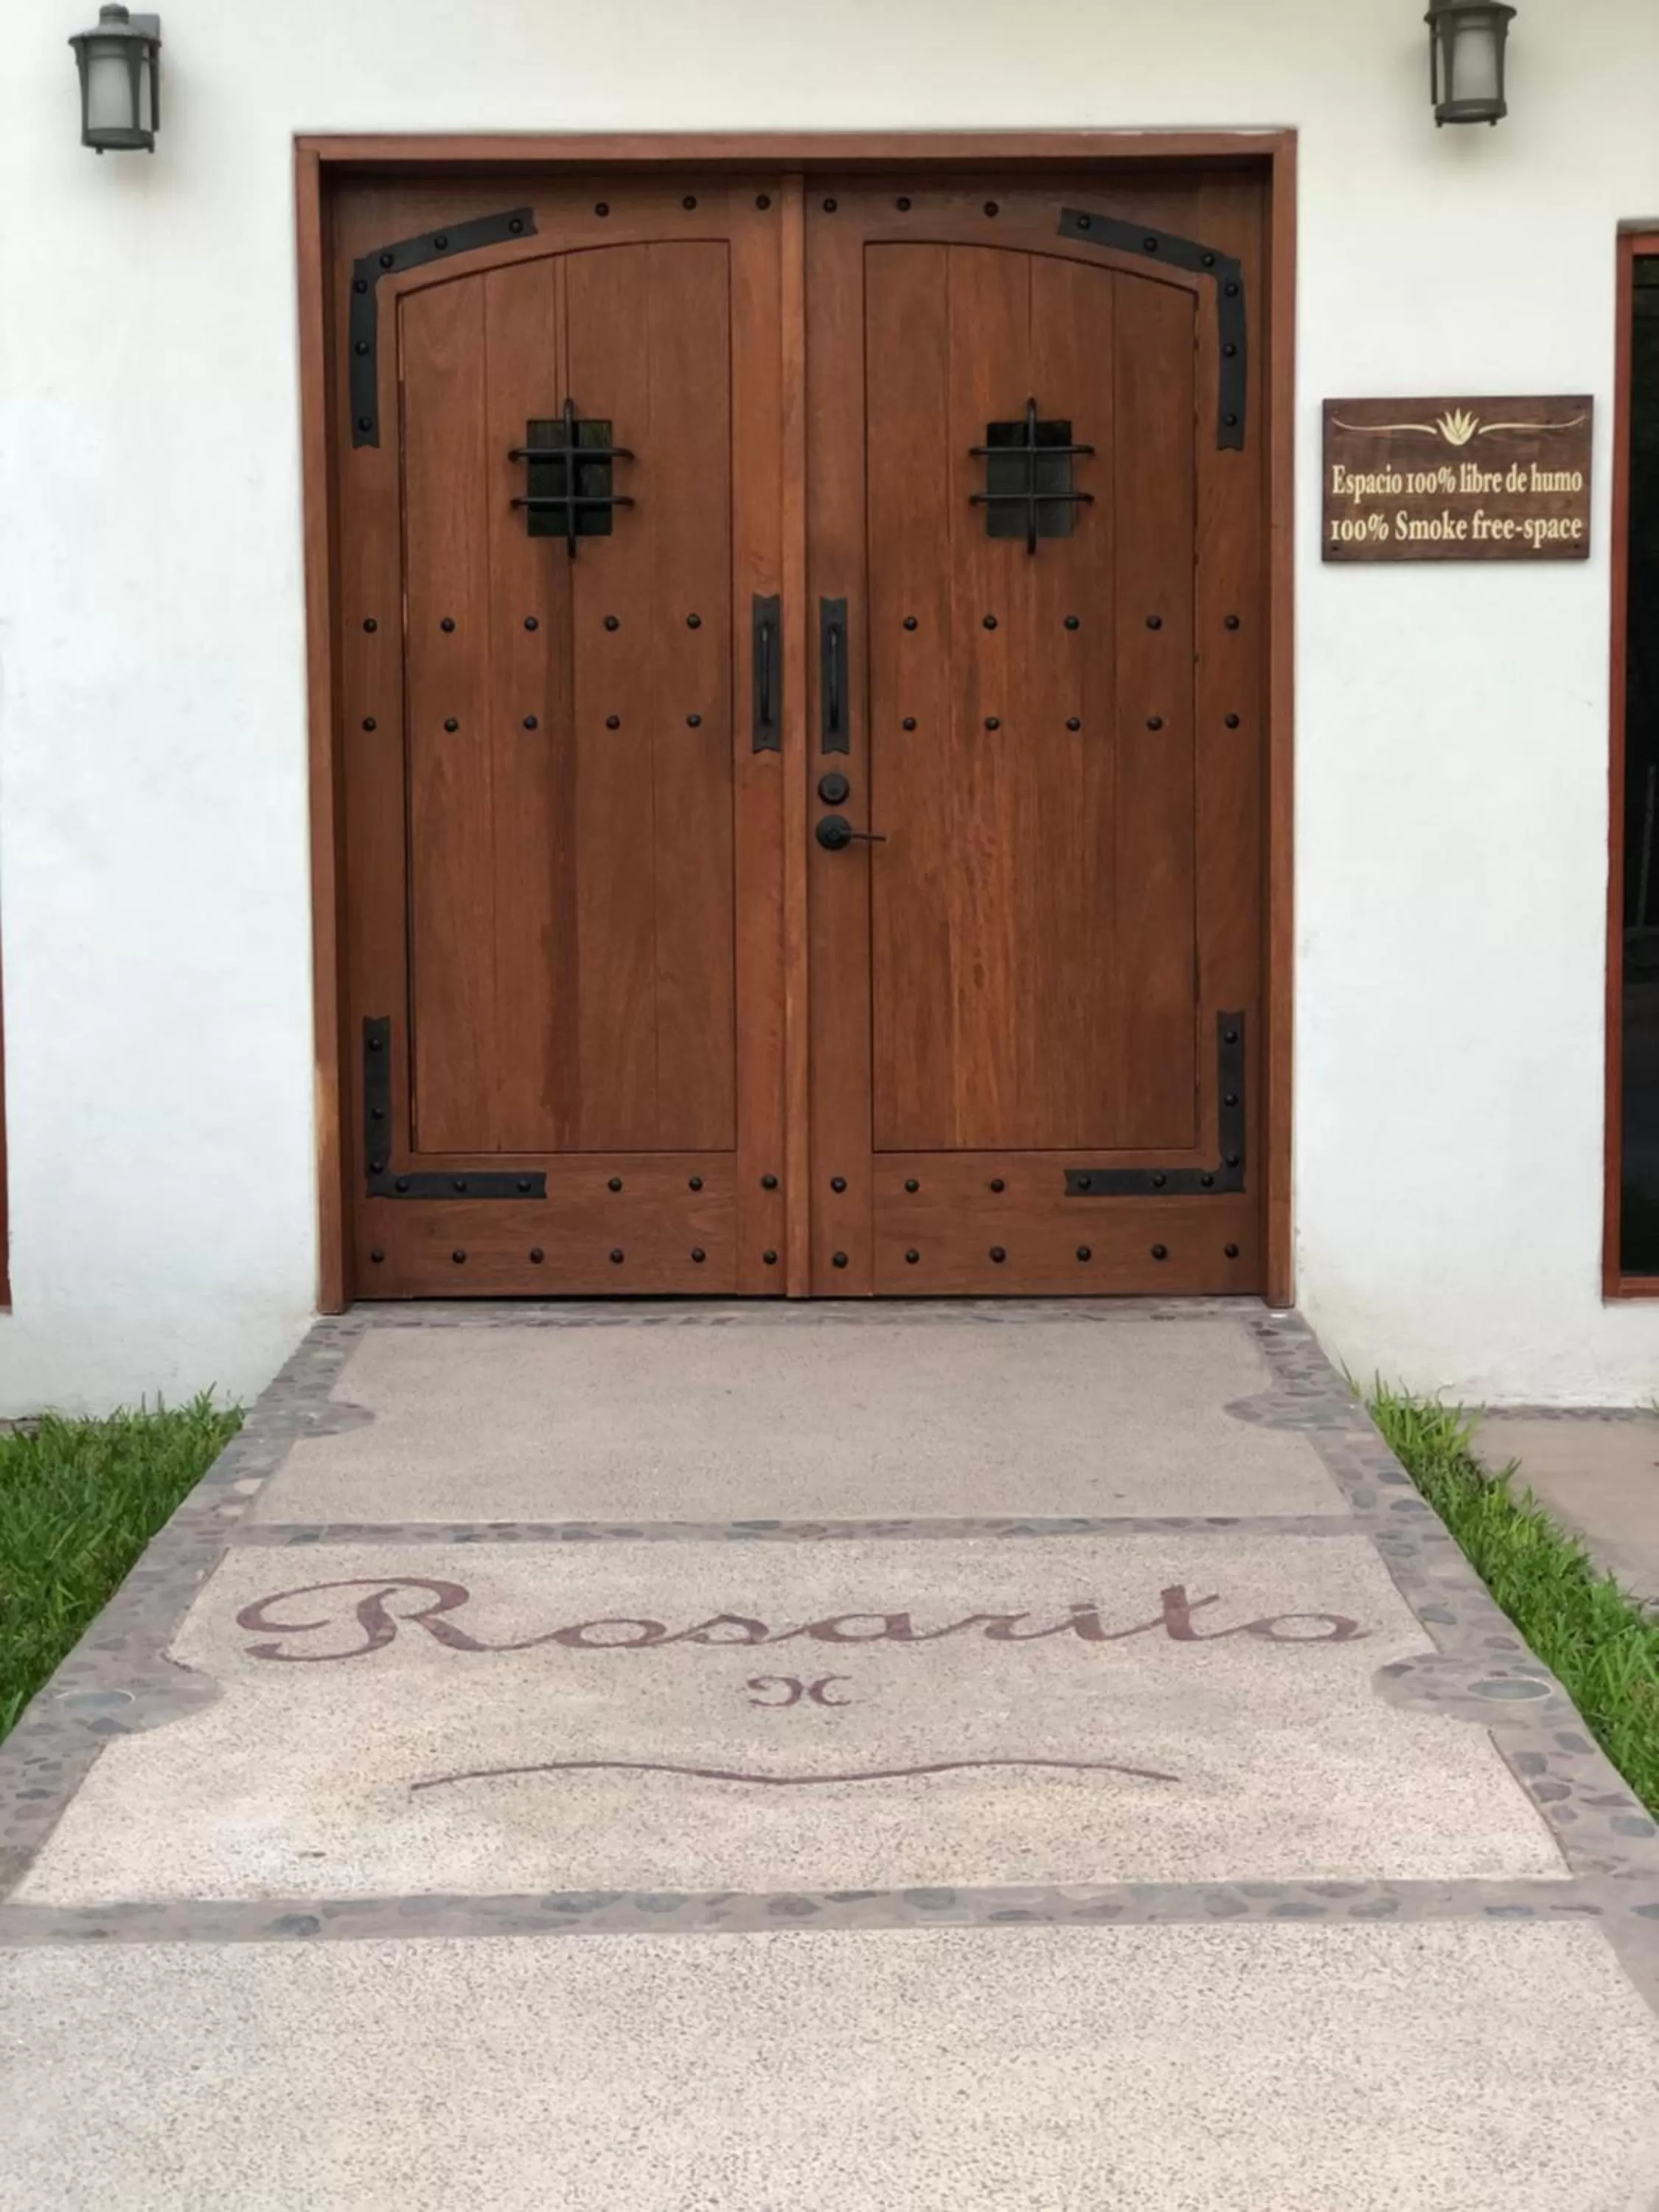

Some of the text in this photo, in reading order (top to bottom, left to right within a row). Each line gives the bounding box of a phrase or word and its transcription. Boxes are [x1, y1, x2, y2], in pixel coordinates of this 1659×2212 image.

[1332, 462, 1582, 504] Espacio 100% libre de humo
[1331, 509, 1582, 549] 100% Smoke free-space
[236, 1577, 1371, 1662] Rosarito
